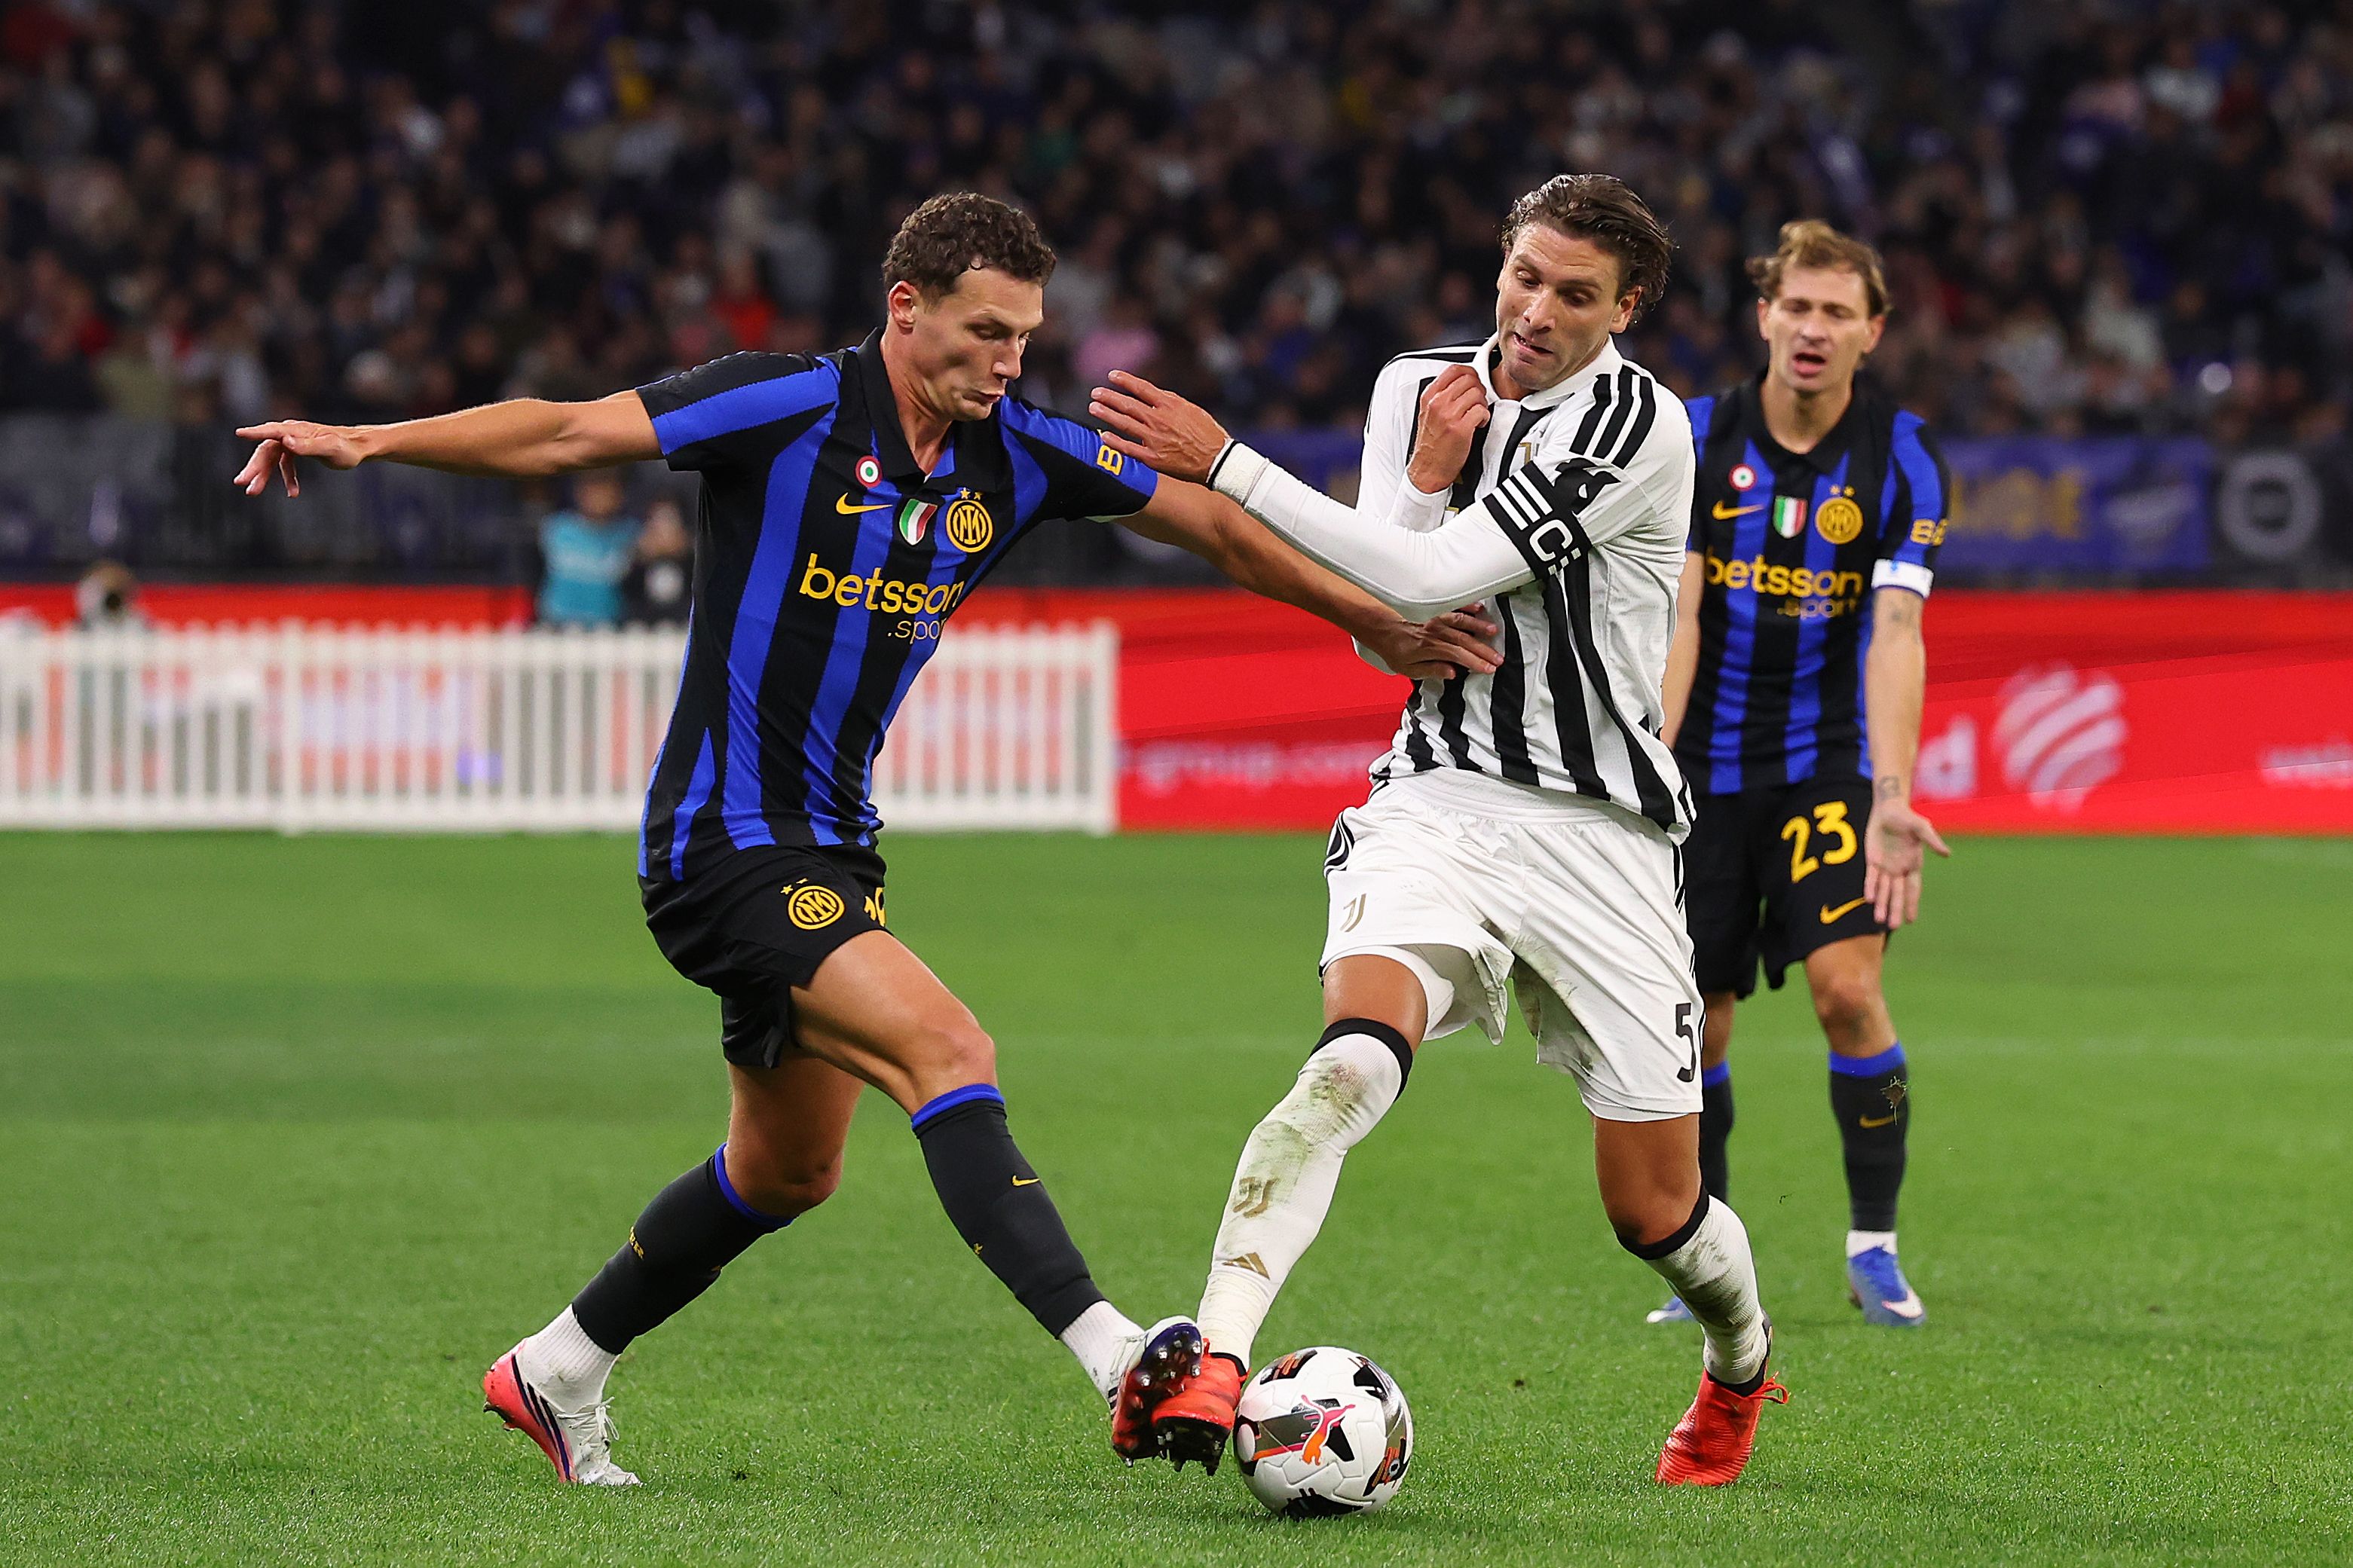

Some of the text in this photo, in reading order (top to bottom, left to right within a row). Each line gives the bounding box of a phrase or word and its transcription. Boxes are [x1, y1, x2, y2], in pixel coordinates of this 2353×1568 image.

[799, 552, 965, 615] betsson
[1705, 544, 1863, 598] betsson
[1780, 799, 1859, 885] 23
[1675, 1002, 1697, 1083] 5
